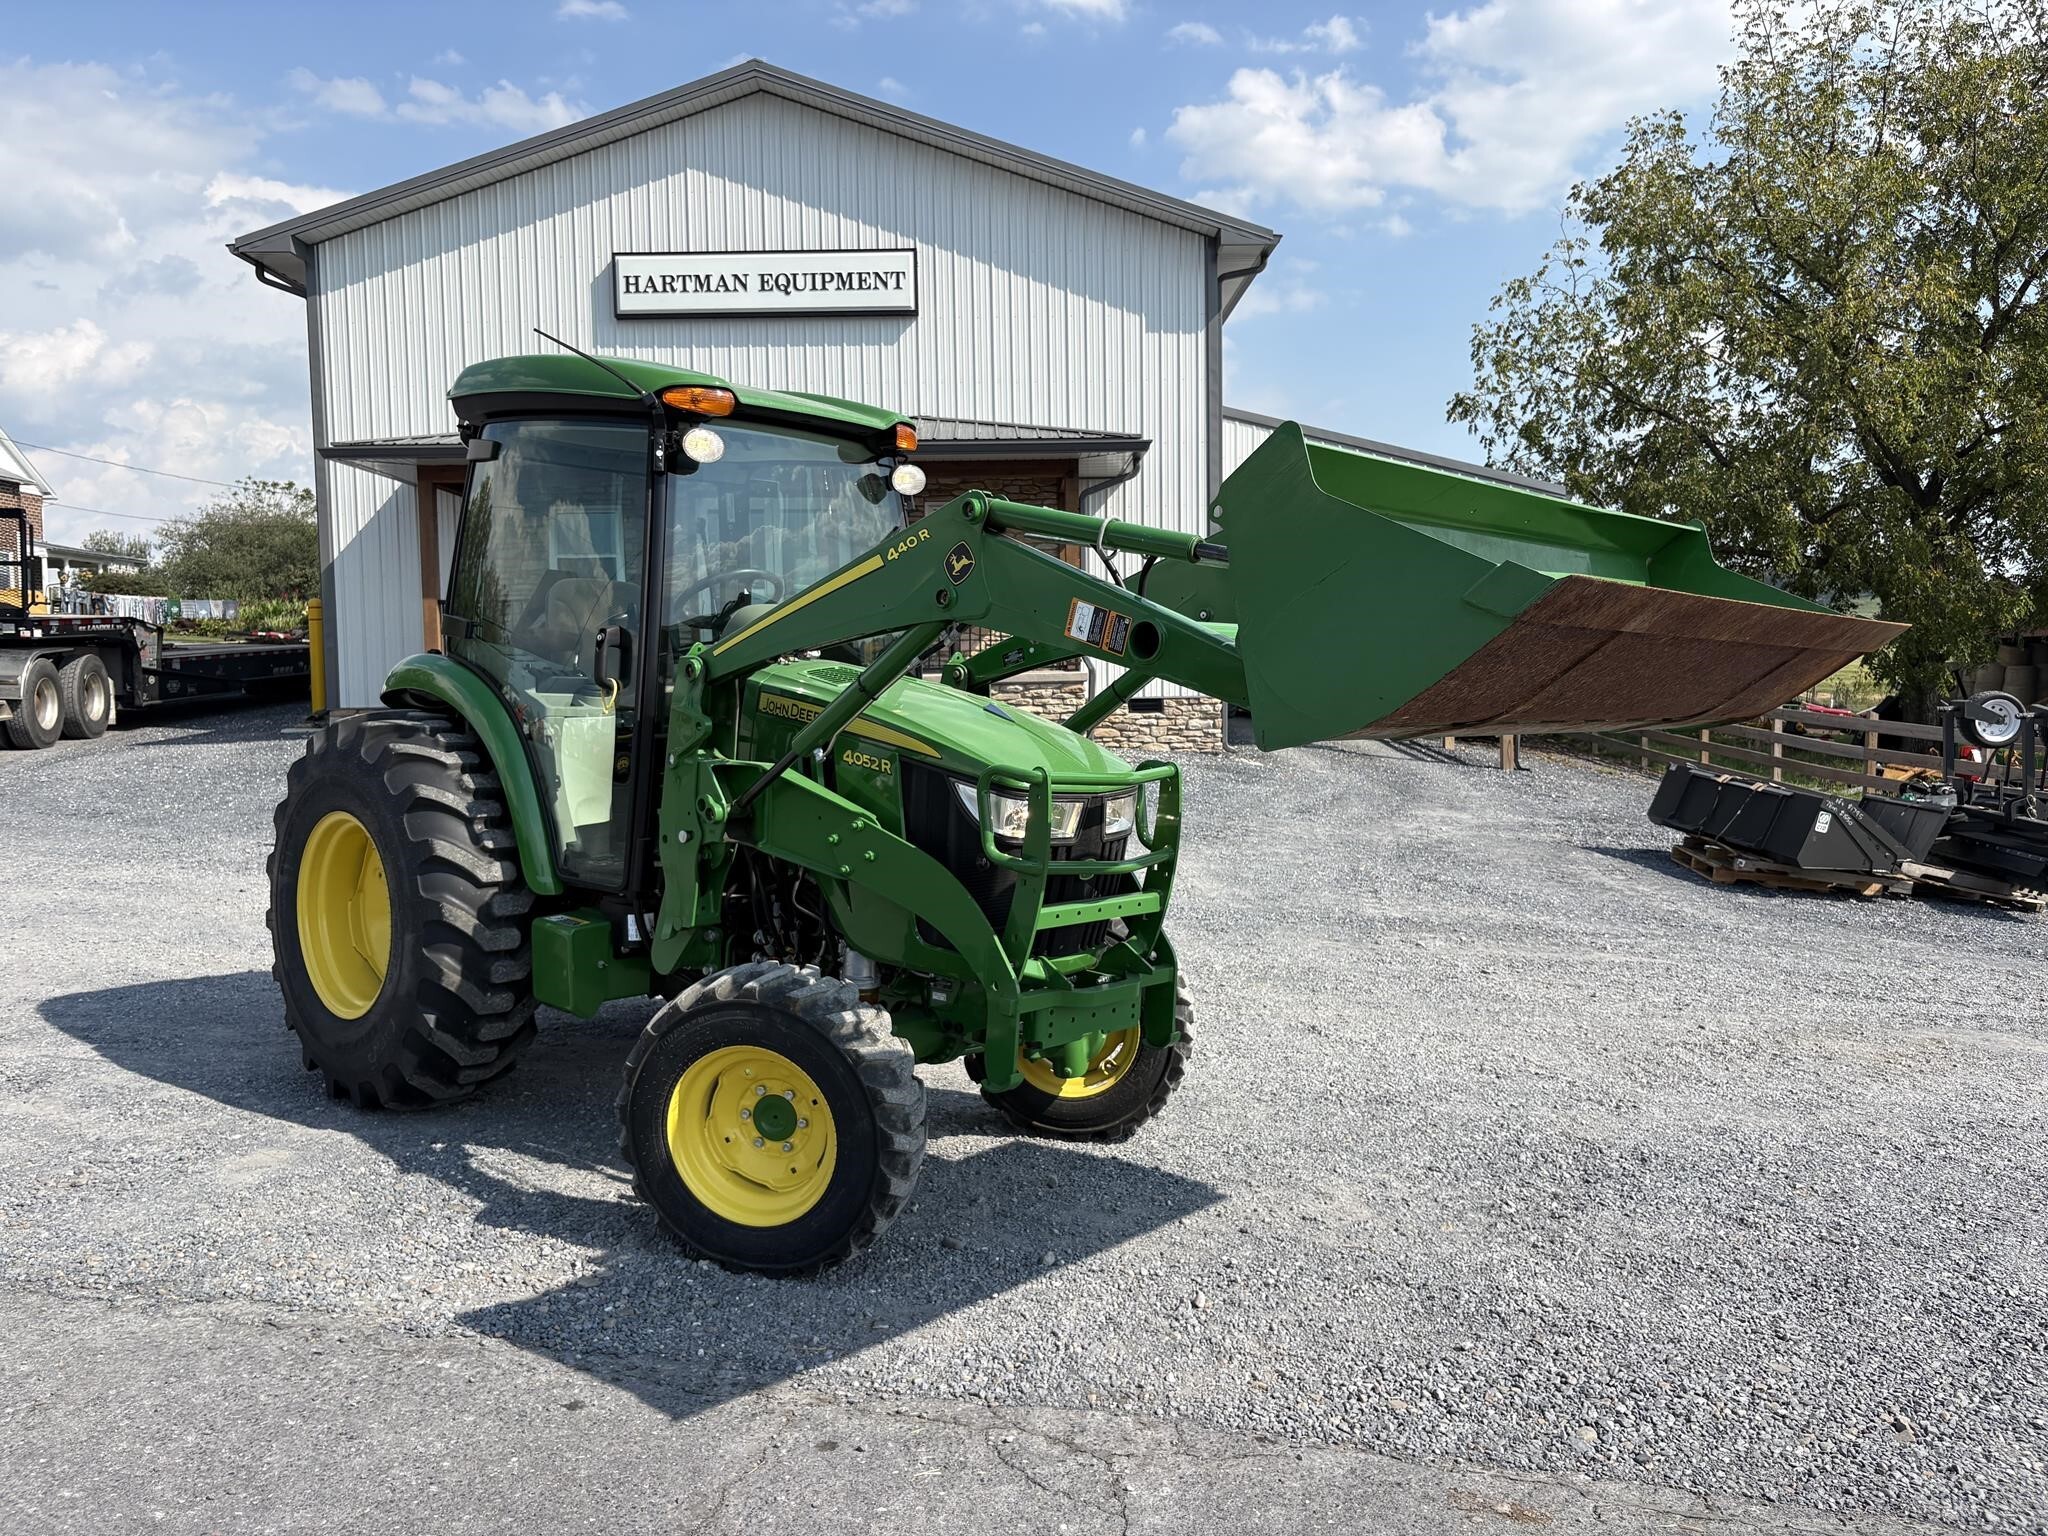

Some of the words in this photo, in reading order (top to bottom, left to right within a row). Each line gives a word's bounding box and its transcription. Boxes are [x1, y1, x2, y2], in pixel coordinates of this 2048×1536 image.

[623, 272, 750, 294] HARTMAN
[758, 271, 906, 295] EQUIPMENT
[762, 698, 789, 715] JOHN
[789, 702, 819, 722] DEE
